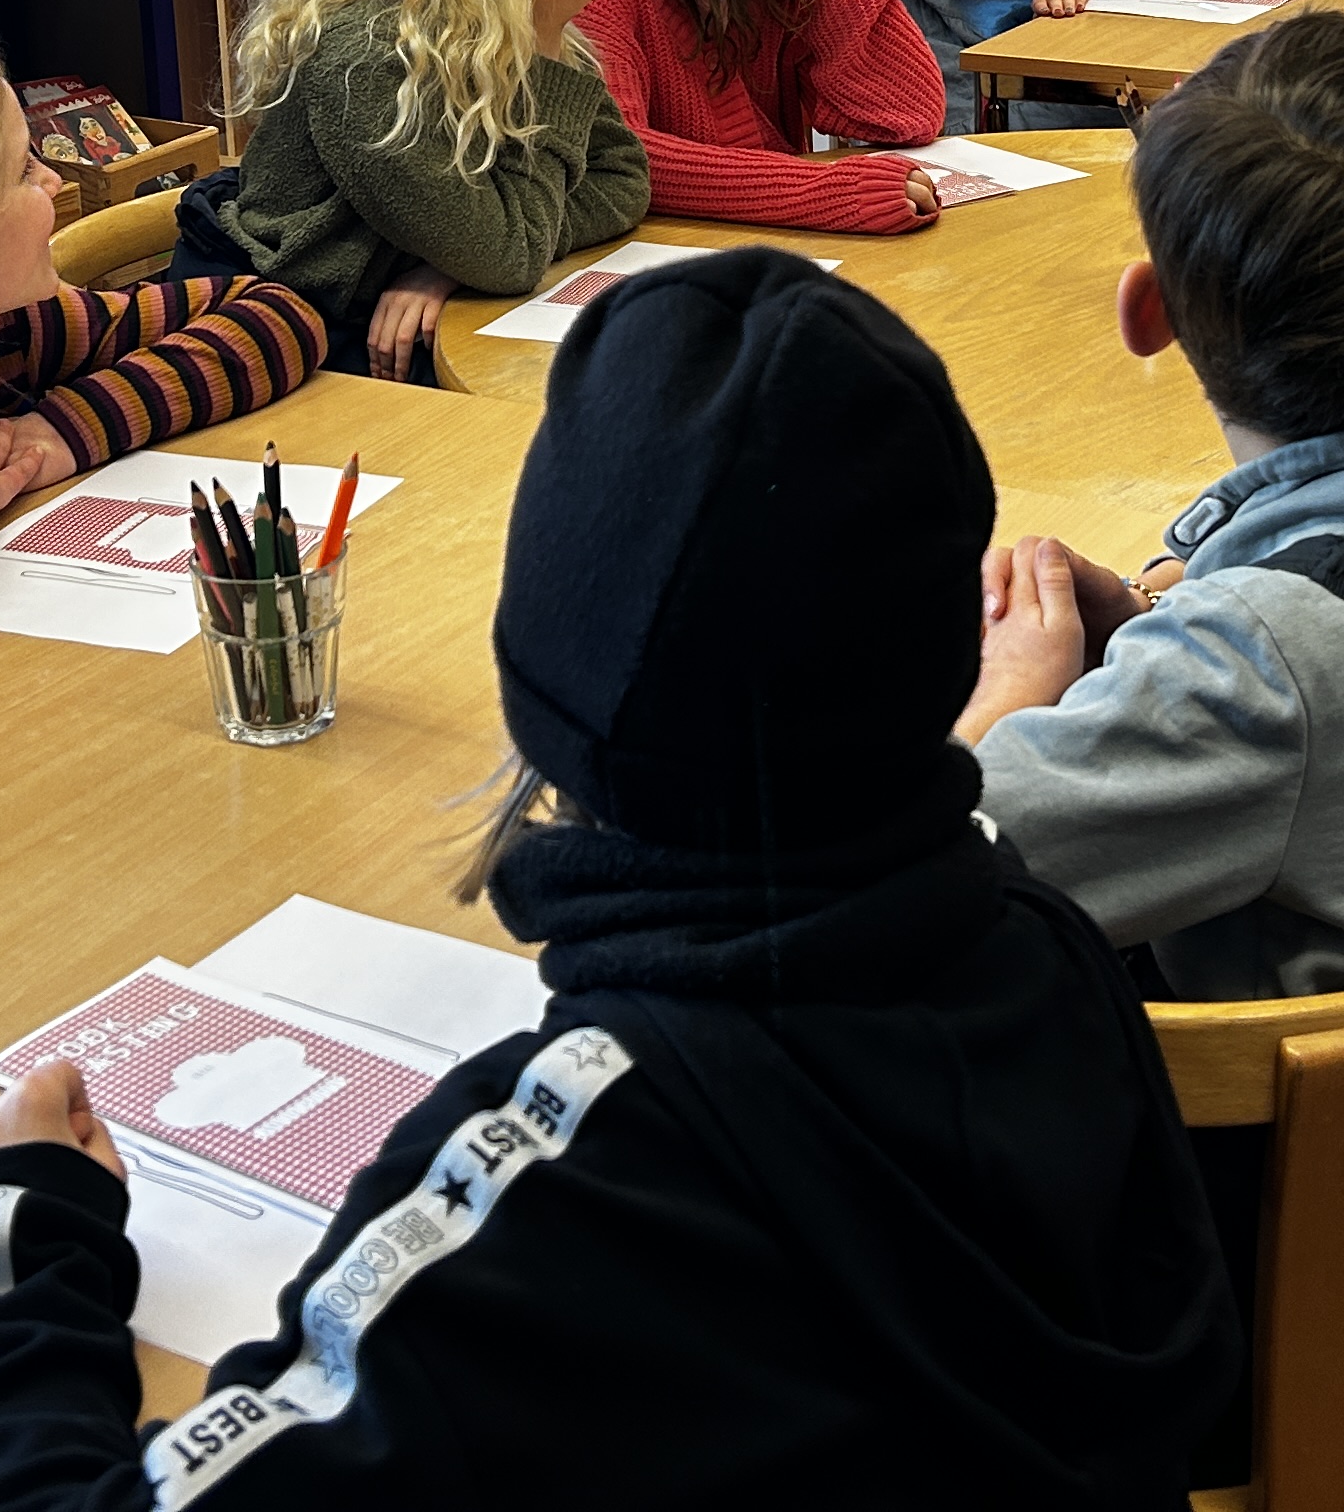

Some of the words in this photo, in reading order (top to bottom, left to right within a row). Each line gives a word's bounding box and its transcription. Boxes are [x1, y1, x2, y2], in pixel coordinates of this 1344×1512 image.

[85, 1002, 200, 1074] ASTING
[524, 1081, 567, 1139] BE
[381, 1207, 446, 1256] BE
[312, 1238, 399, 1337] COOL
[170, 1394, 267, 1474] BEST
